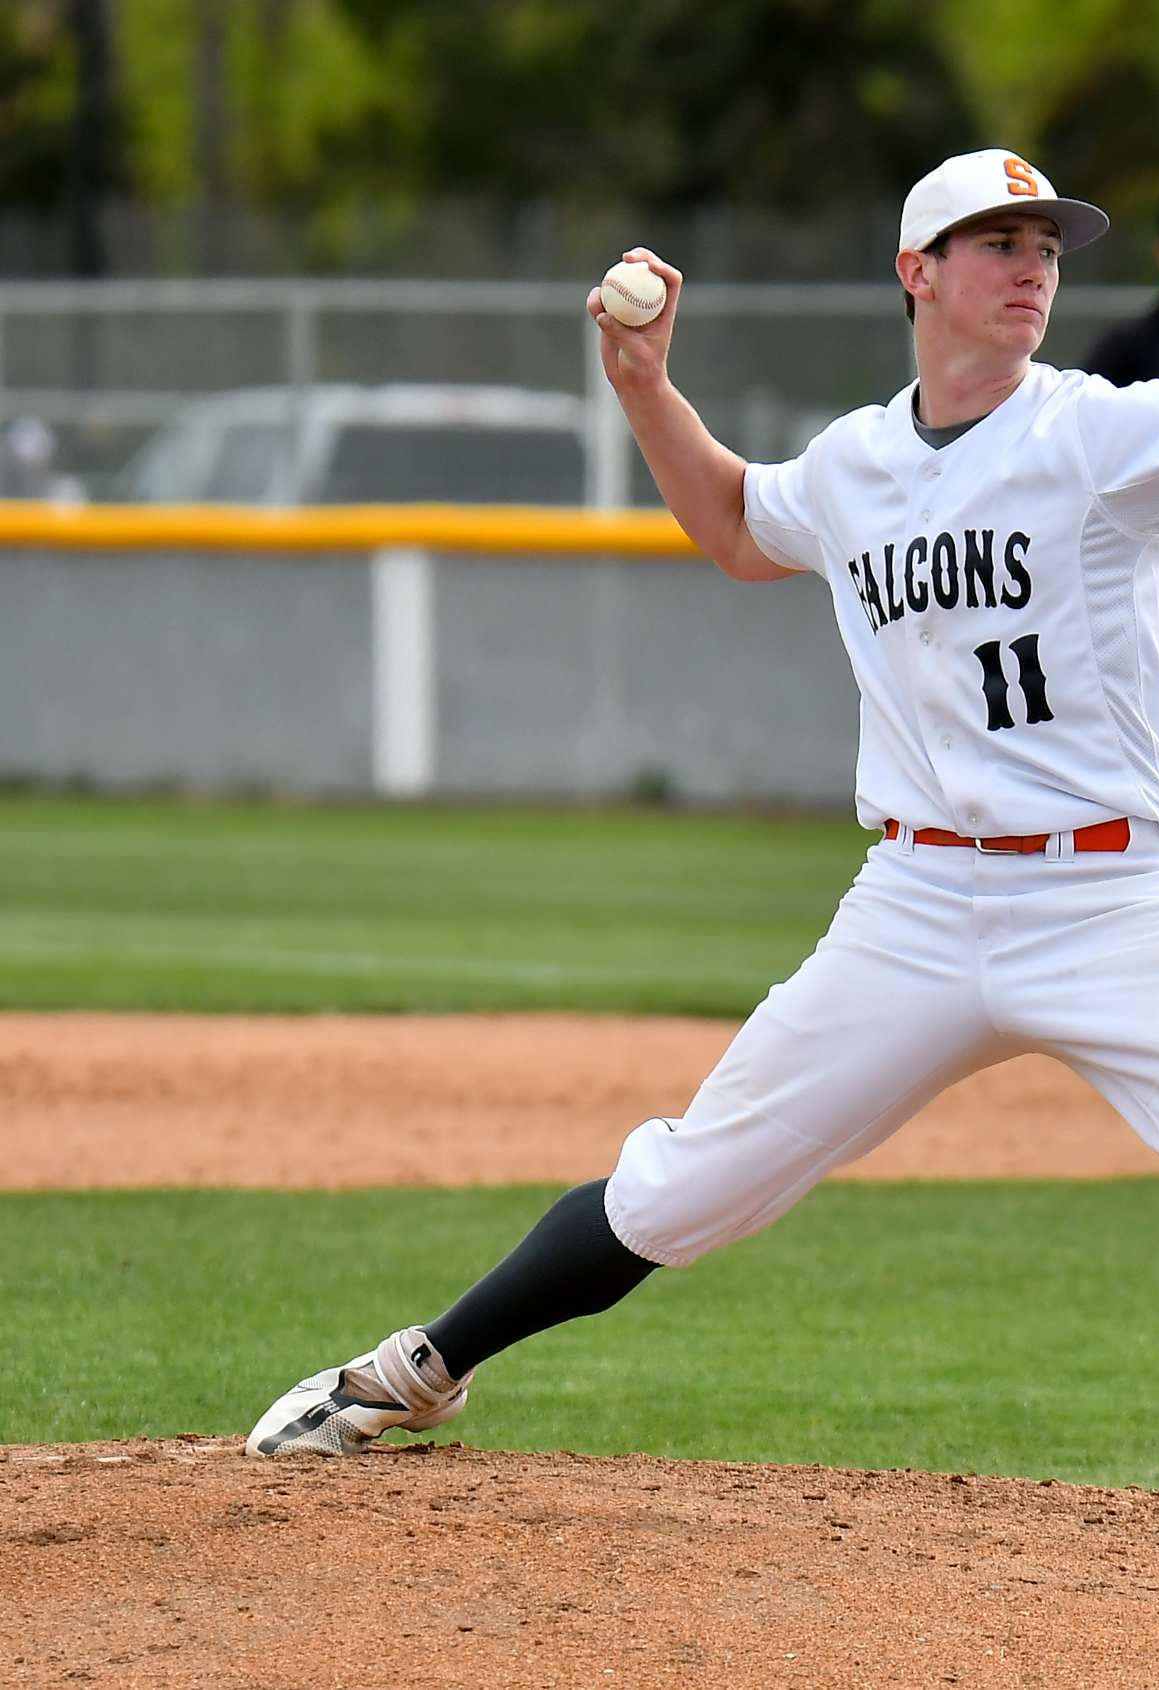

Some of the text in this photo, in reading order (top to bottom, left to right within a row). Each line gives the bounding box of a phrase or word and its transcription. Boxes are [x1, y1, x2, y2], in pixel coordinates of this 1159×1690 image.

[1004, 159, 1038, 196] S
[848, 529, 1032, 636] FALCONS
[973, 634, 1054, 731] 11
